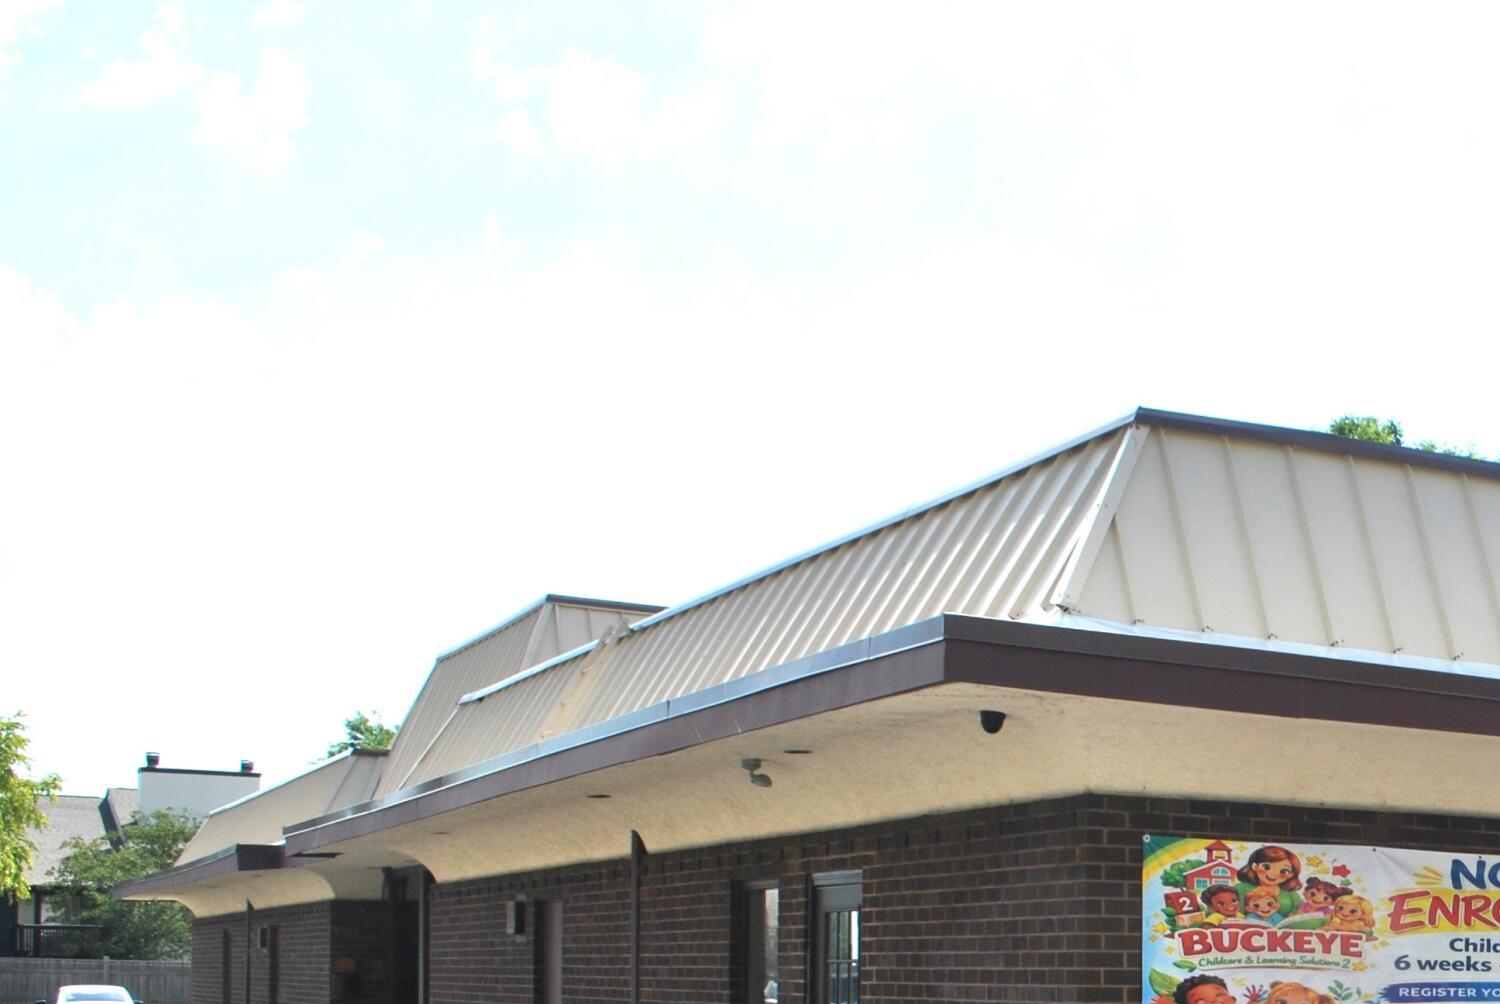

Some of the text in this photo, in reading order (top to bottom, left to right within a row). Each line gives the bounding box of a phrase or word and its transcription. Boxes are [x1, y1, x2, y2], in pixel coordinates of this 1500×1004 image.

[1178, 929, 1363, 958] BUCKEYE
[1198, 956, 1351, 969] Childcare & Learning Solutions 2
[1394, 955, 1411, 971] 6
[1416, 956, 1492, 972] weeks
[1399, 987, 1477, 998] REGISTER
